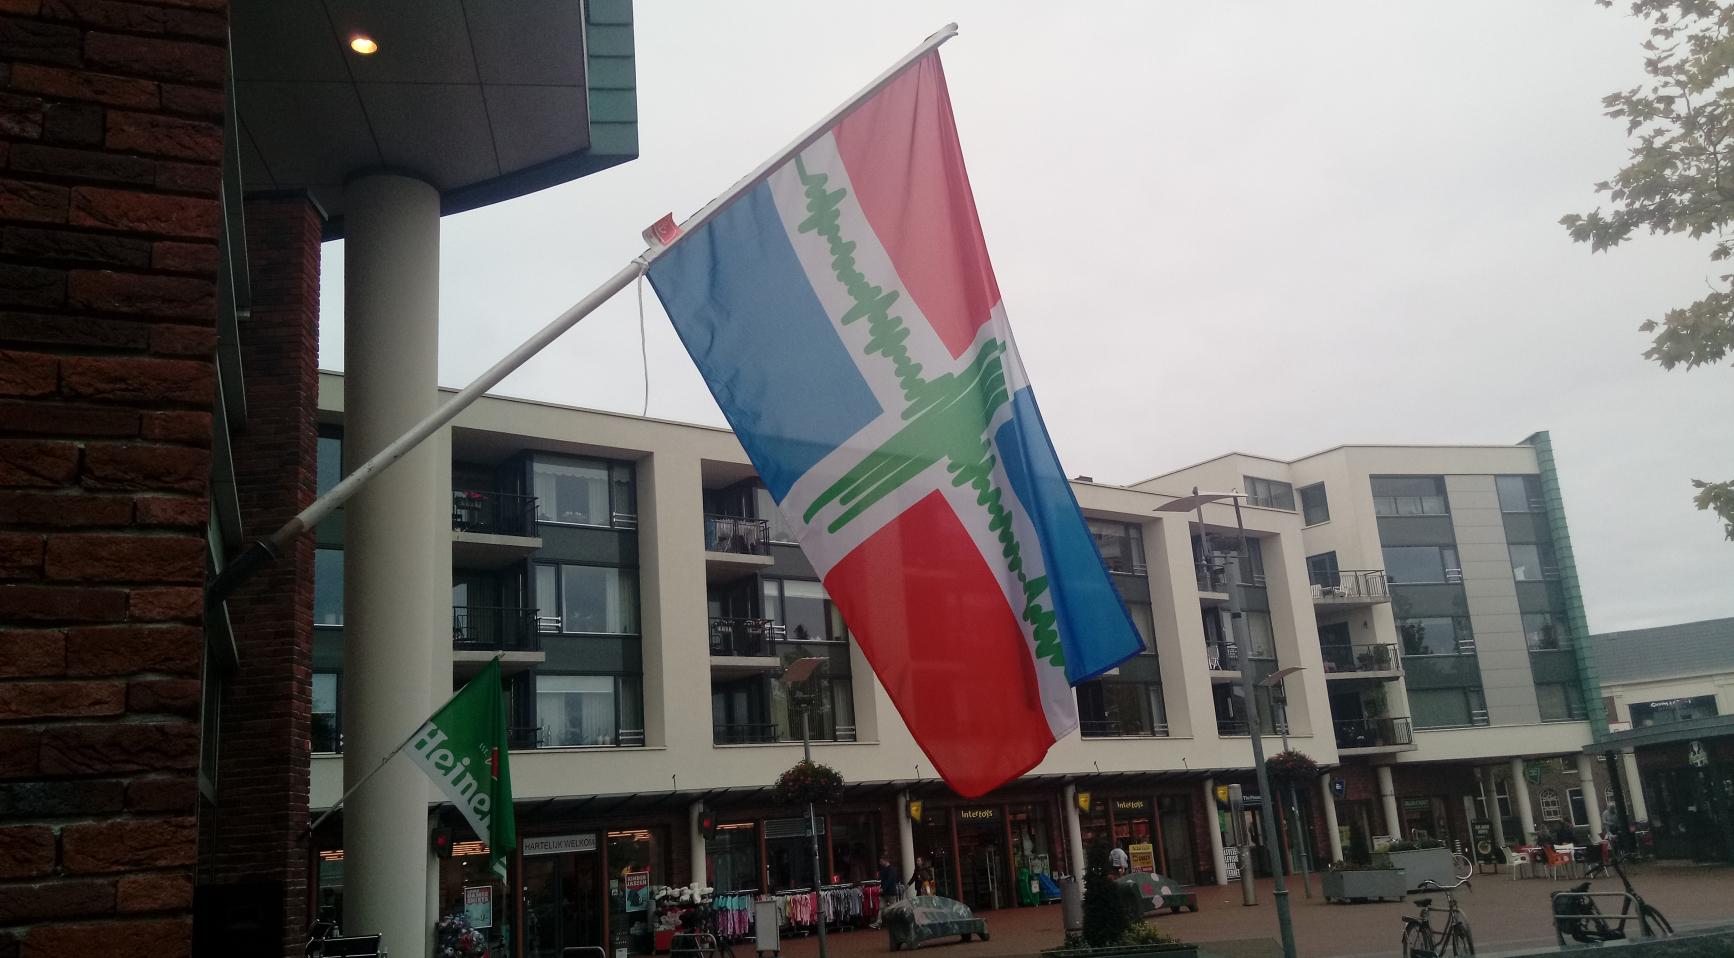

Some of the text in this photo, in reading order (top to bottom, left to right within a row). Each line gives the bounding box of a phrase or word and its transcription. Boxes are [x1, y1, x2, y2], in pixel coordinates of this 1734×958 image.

[406, 721, 491, 833] Heine
[961, 809, 993, 819] Intertoys
[524, 840, 563, 851] HARTELIJK
